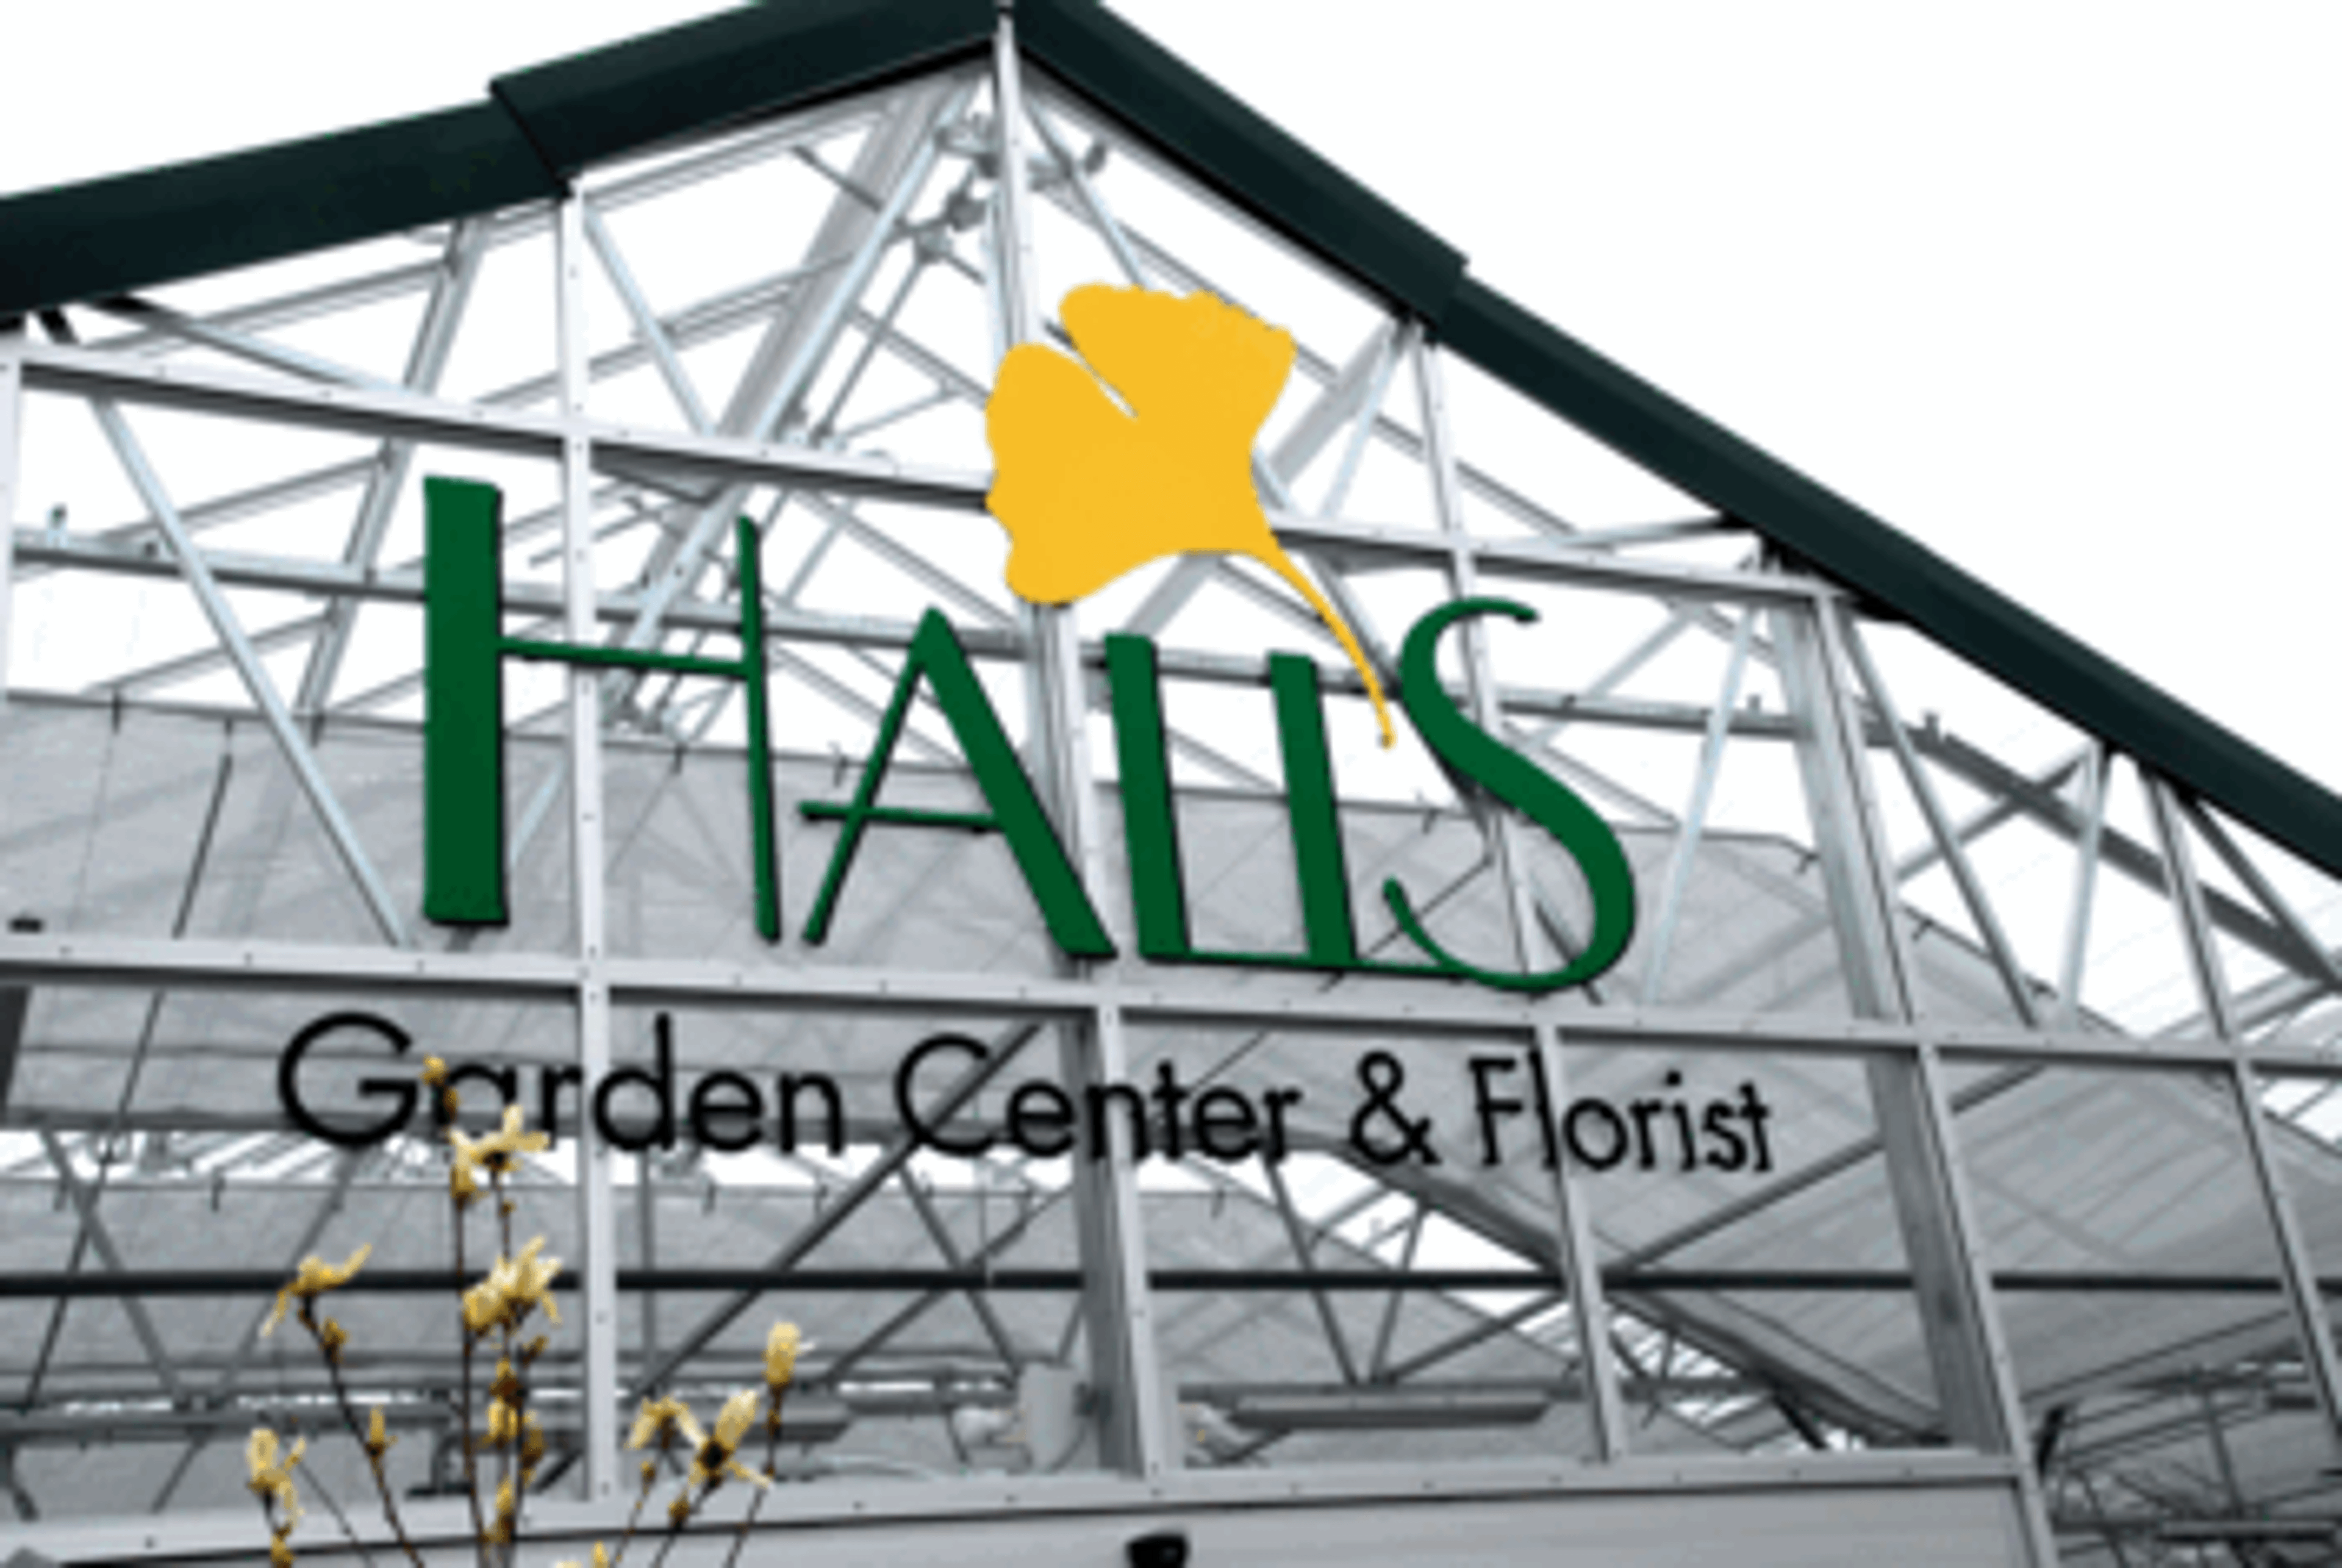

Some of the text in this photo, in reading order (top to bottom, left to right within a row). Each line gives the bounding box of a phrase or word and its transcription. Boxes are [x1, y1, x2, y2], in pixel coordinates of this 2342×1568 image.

[277, 1010, 1774, 1172] Garden Center & Florist
